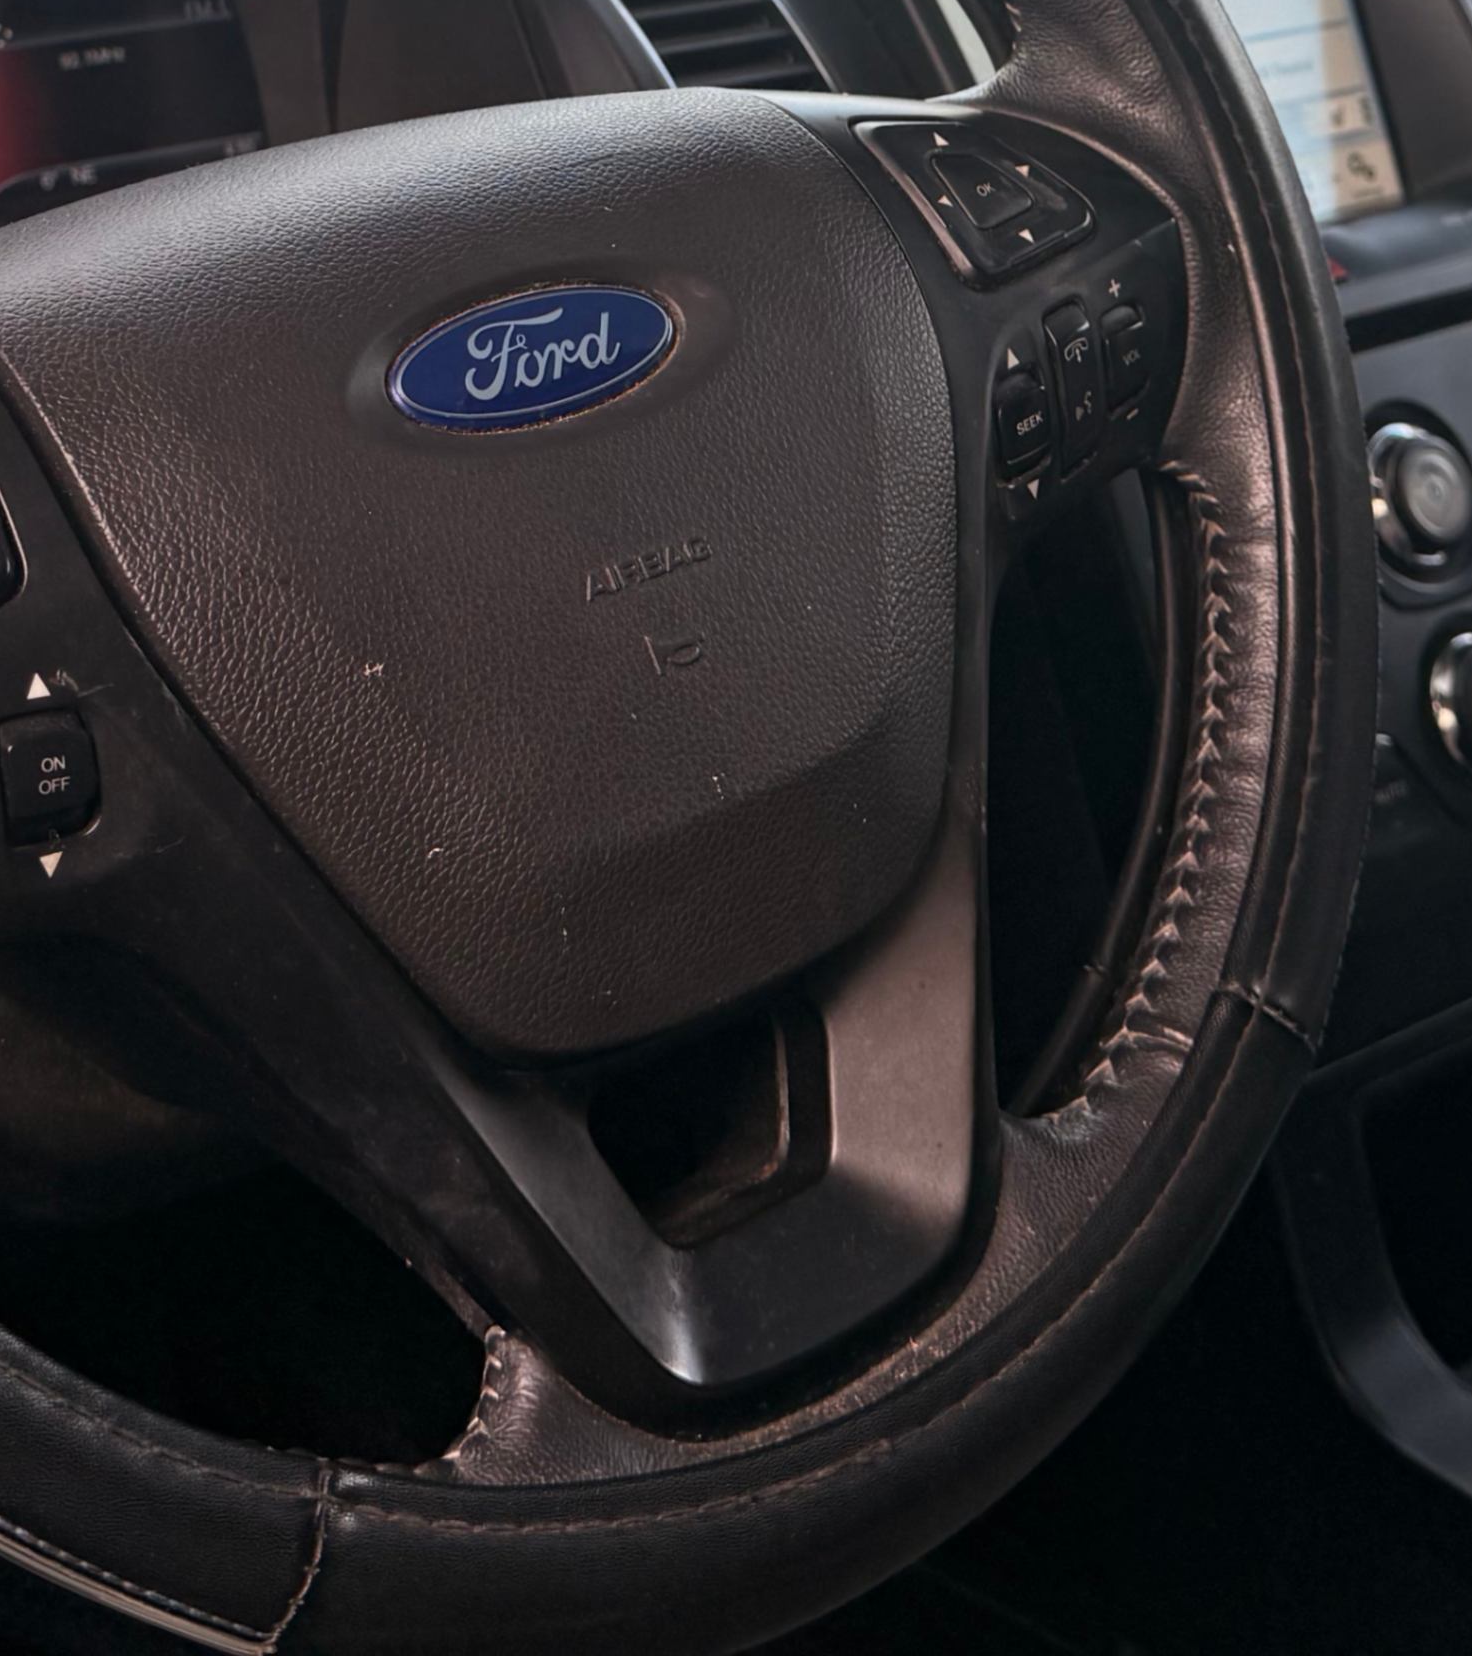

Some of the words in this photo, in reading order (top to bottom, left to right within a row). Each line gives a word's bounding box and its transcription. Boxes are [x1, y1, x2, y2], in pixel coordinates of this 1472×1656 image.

[975, 182, 993, 198] OK
[464, 306, 622, 402] Ford
[1015, 409, 1044, 436] SEEK
[584, 535, 714, 603] AIRBAG
[40, 754, 67, 773] ON
[37, 775, 72, 796] OFF
